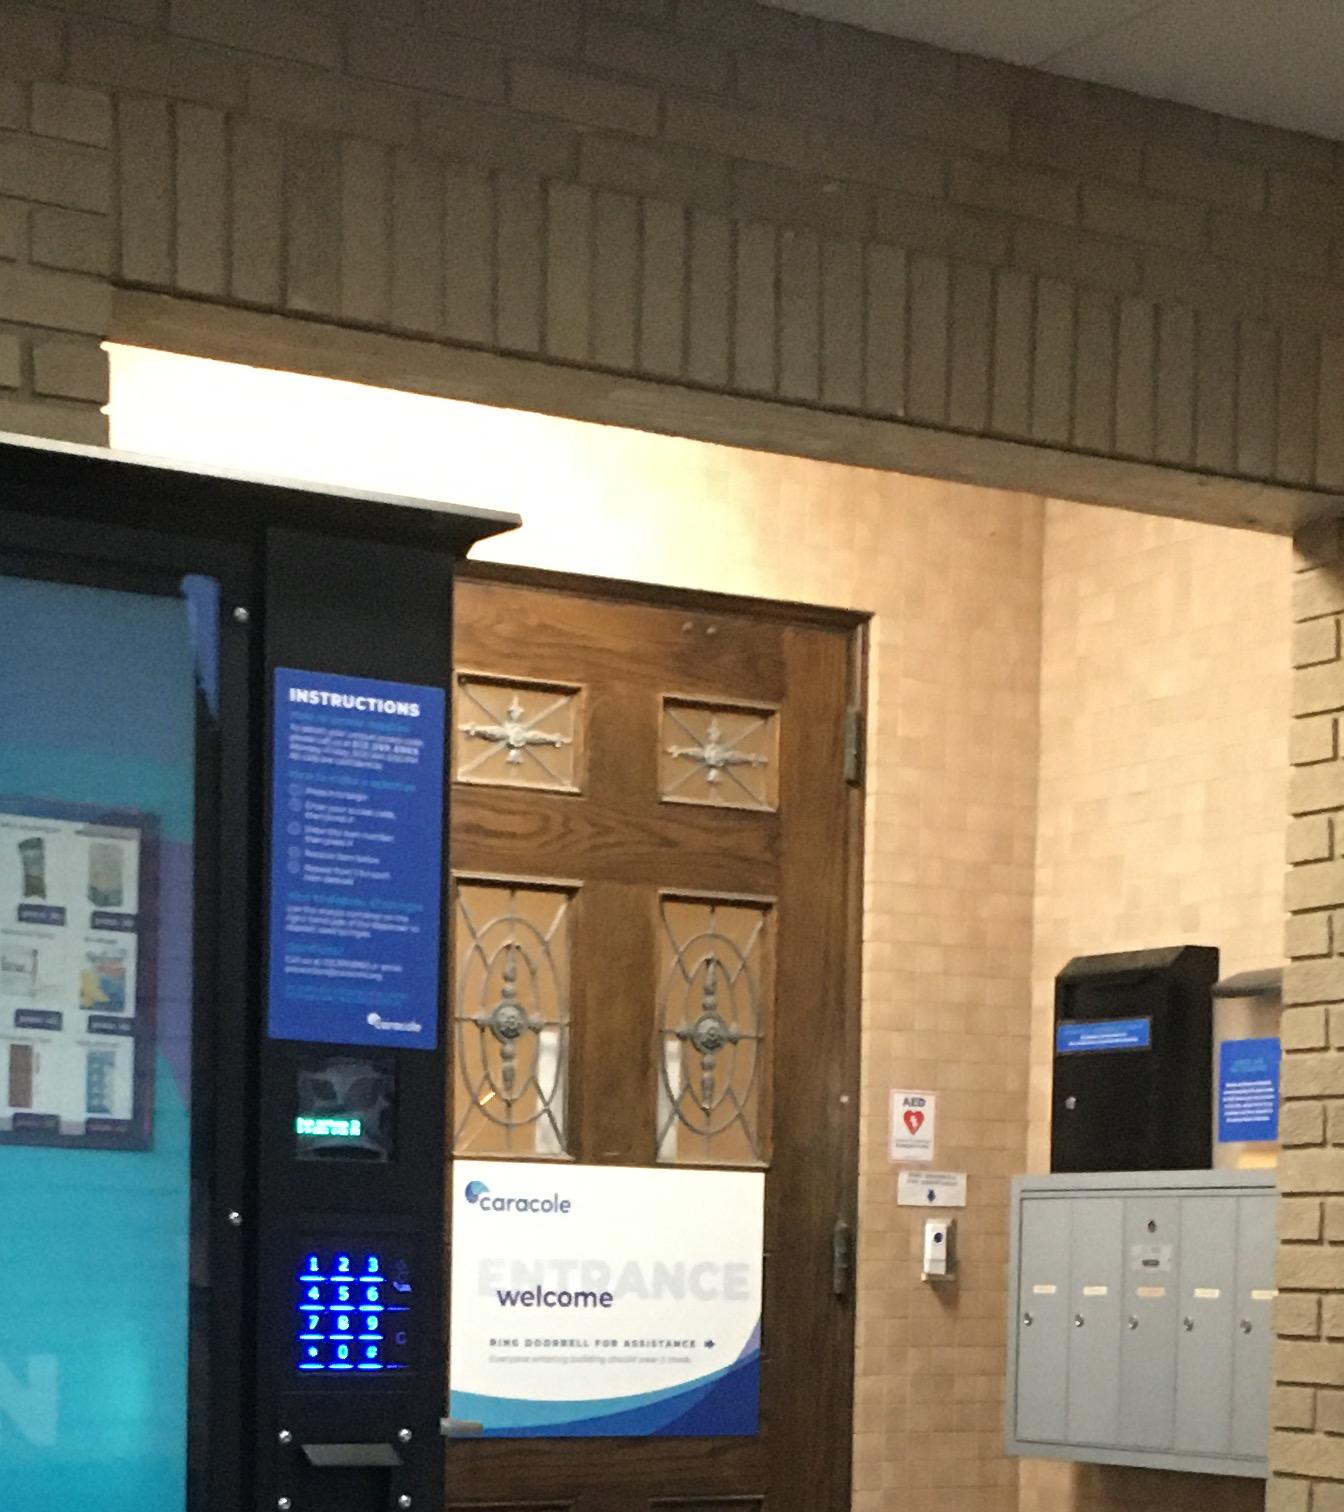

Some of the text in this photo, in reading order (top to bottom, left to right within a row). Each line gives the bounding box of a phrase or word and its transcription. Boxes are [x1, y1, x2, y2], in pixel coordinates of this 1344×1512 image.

[288, 687, 421, 718] INSTRUCTIONS
[903, 1097, 926, 1108] AED
[479, 1193, 572, 1214] caracole
[309, 1256, 379, 1273] 1 2 3
[478, 1258, 752, 1302] ENTRANCE
[307, 1286, 379, 1302] 4 5 6
[497, 1285, 614, 1308] welcome
[308, 1314, 378, 1331] 7 8 9
[337, 1344, 349, 1359] 0
[595, 1339, 618, 1348] FOR
[623, 1340, 696, 1348] ASSISTANCE
